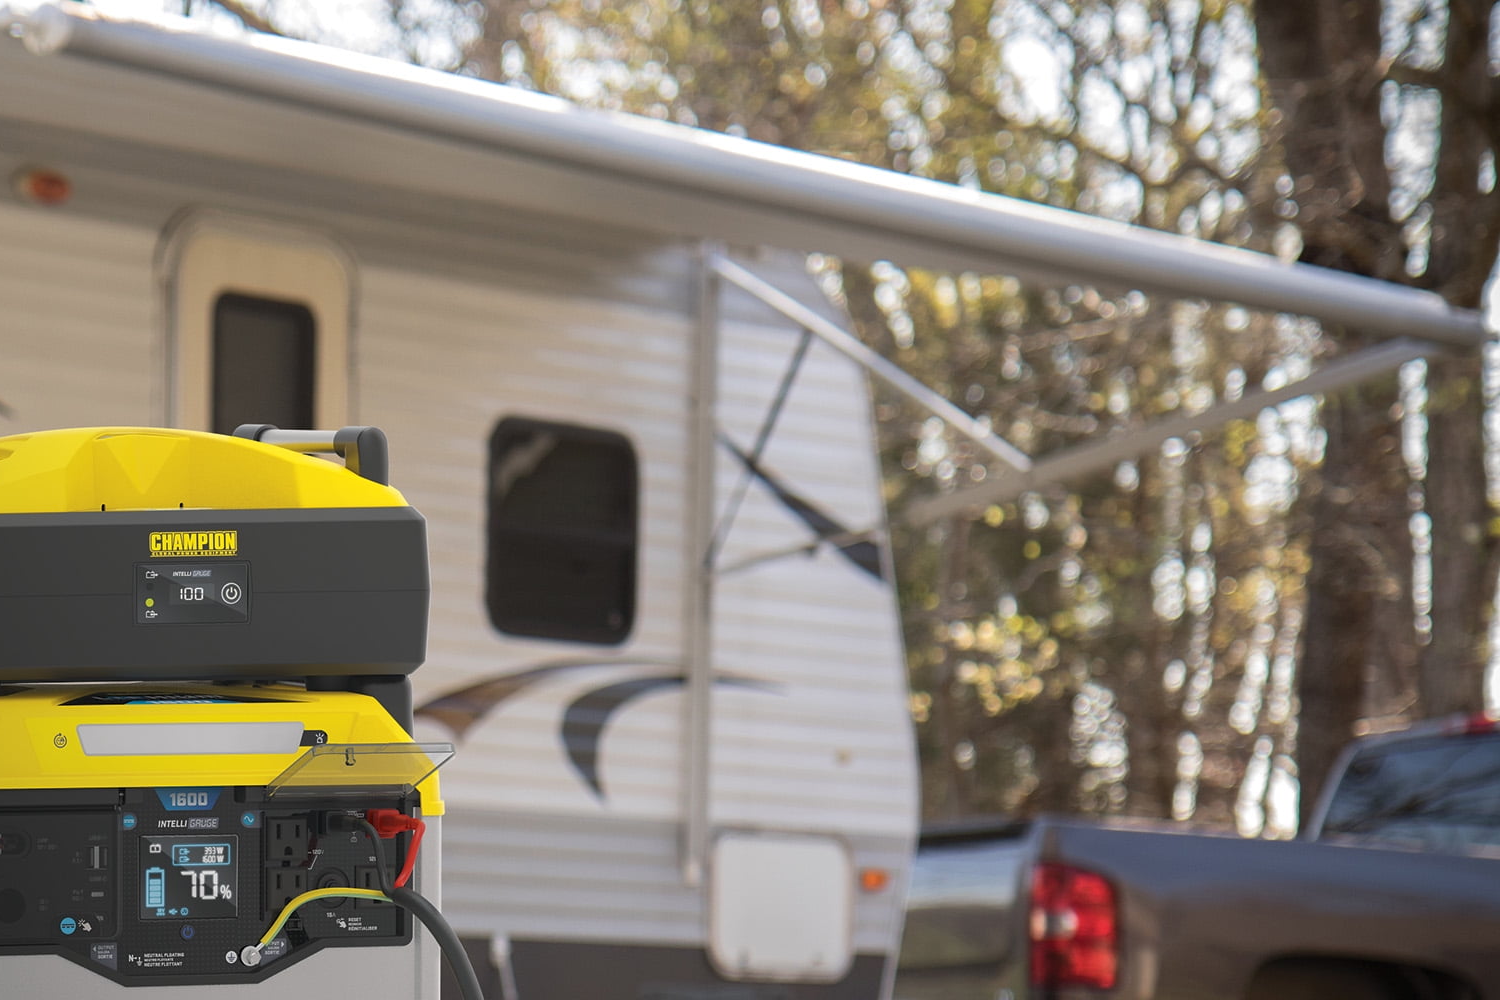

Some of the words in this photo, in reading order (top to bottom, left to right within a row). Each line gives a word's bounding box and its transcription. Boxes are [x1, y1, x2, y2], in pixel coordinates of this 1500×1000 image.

[150, 532, 236, 551] CHAMPION
[180, 587, 204, 601] 100
[170, 792, 208, 807] 1600
[157, 819, 188, 828] INTELLI
[189, 818, 218, 828] GAUGE
